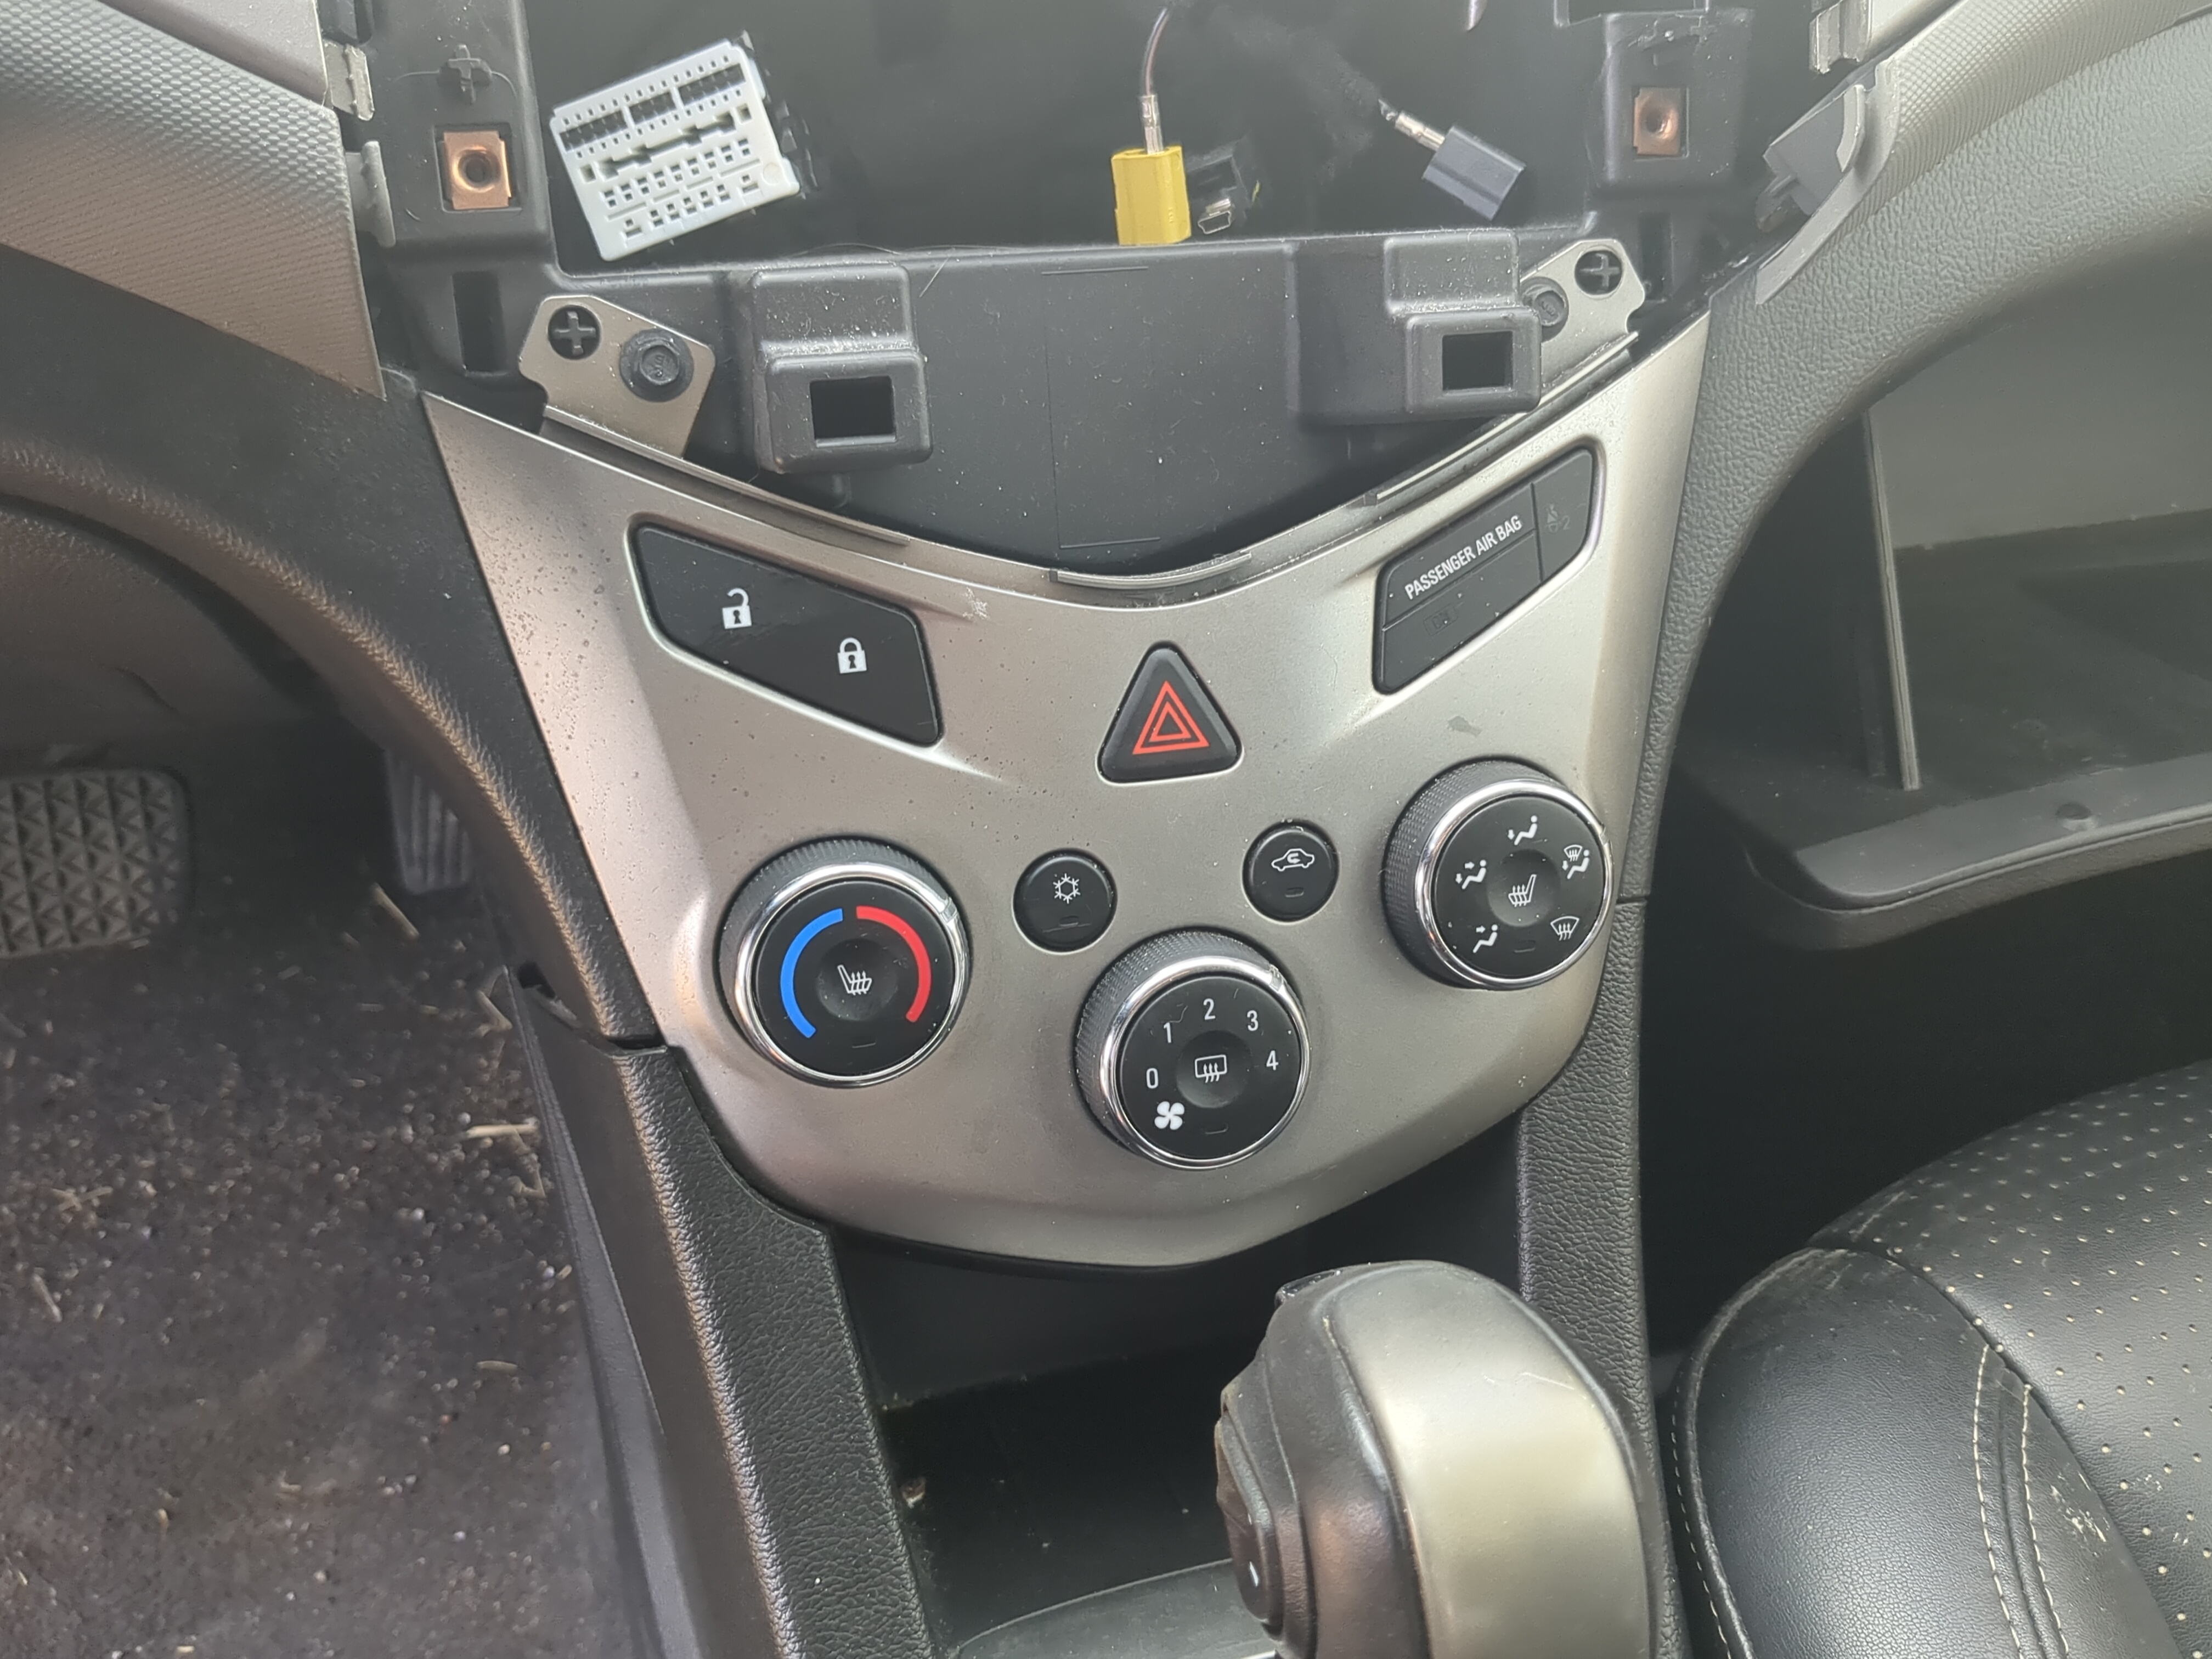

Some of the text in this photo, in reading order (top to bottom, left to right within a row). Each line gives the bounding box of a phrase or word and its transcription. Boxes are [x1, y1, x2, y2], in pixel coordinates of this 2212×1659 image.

[1404, 515, 1522, 600] PASSENGER AIR BAG
[1203, 998, 1216, 1020] 2
[1246, 1010, 1259, 1031] 3
[1163, 1022, 1172, 1043] 1
[1266, 1050, 1279, 1071] 4
[1146, 1068, 1159, 1090] 0
